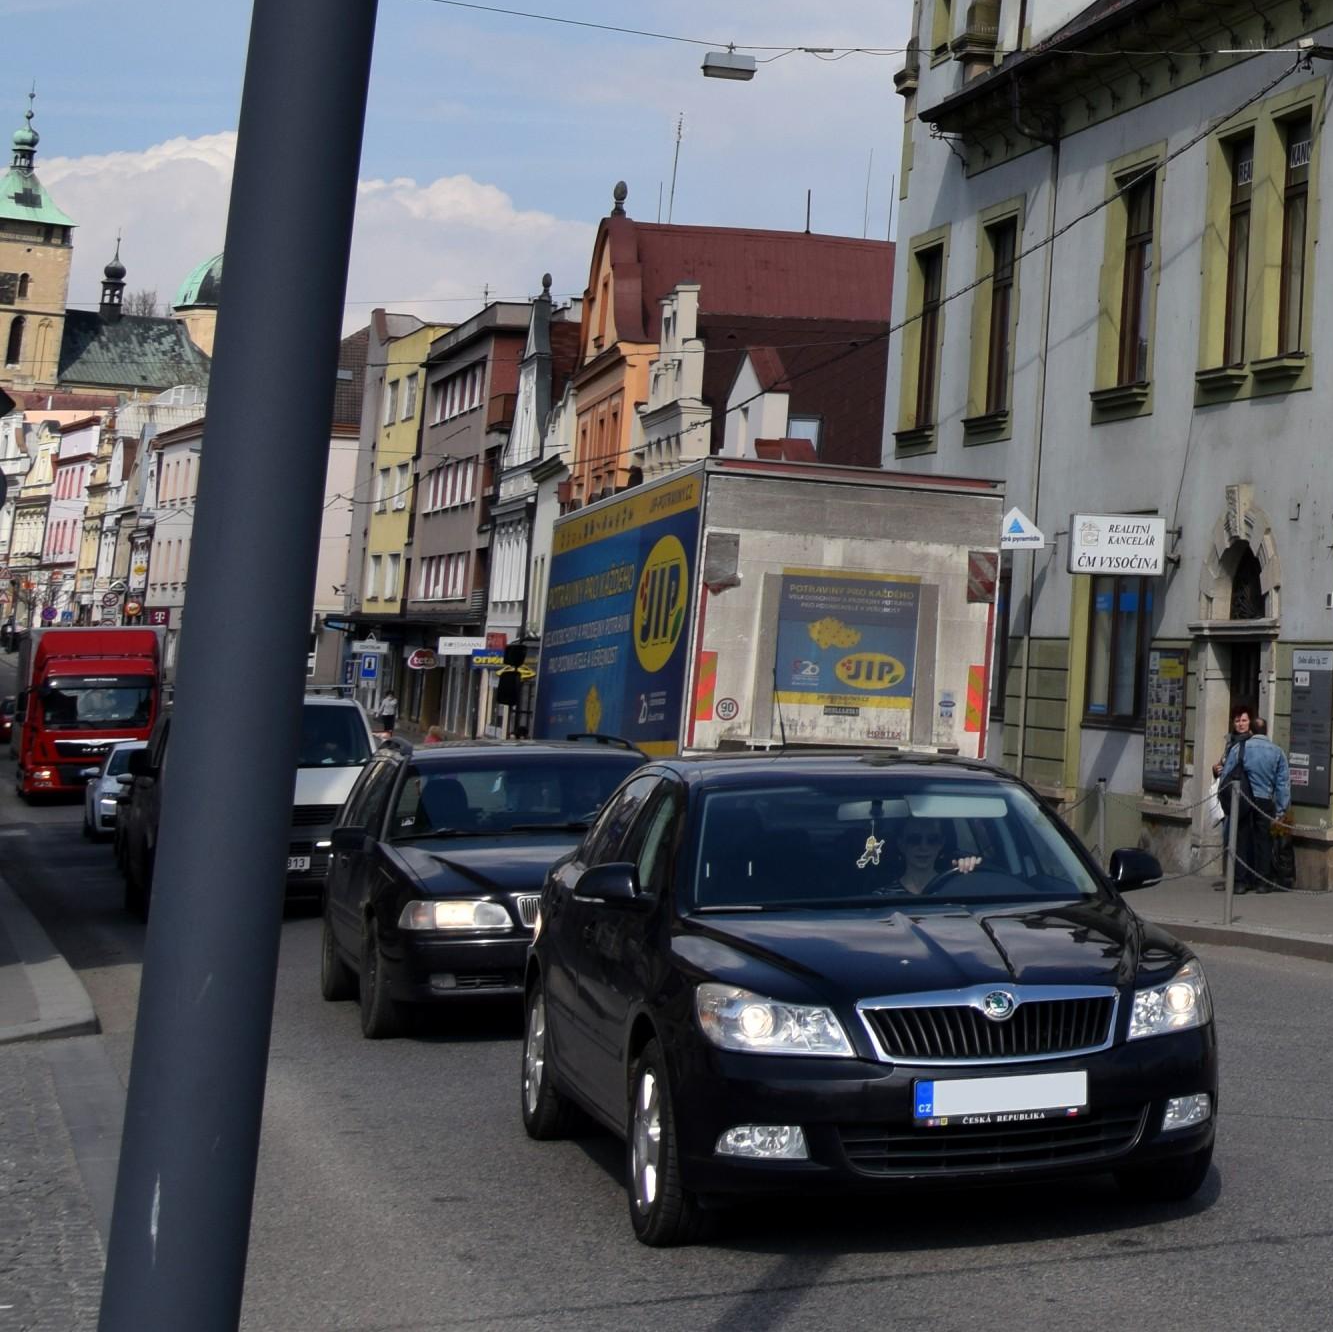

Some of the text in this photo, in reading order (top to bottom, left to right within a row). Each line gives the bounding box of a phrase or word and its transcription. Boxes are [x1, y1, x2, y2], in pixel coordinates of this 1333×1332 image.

[1108, 524, 1151, 534] REALITNÍ
[1108, 535, 1155, 546] KANCELÁŘ
[1077, 553, 1159, 569] ČM VYSOČINA
[848, 661, 895, 681] JIP
[918, 1104, 932, 1113] CZ
[962, 1112, 1045, 1125] ČESKÁ REPUBLIKA
